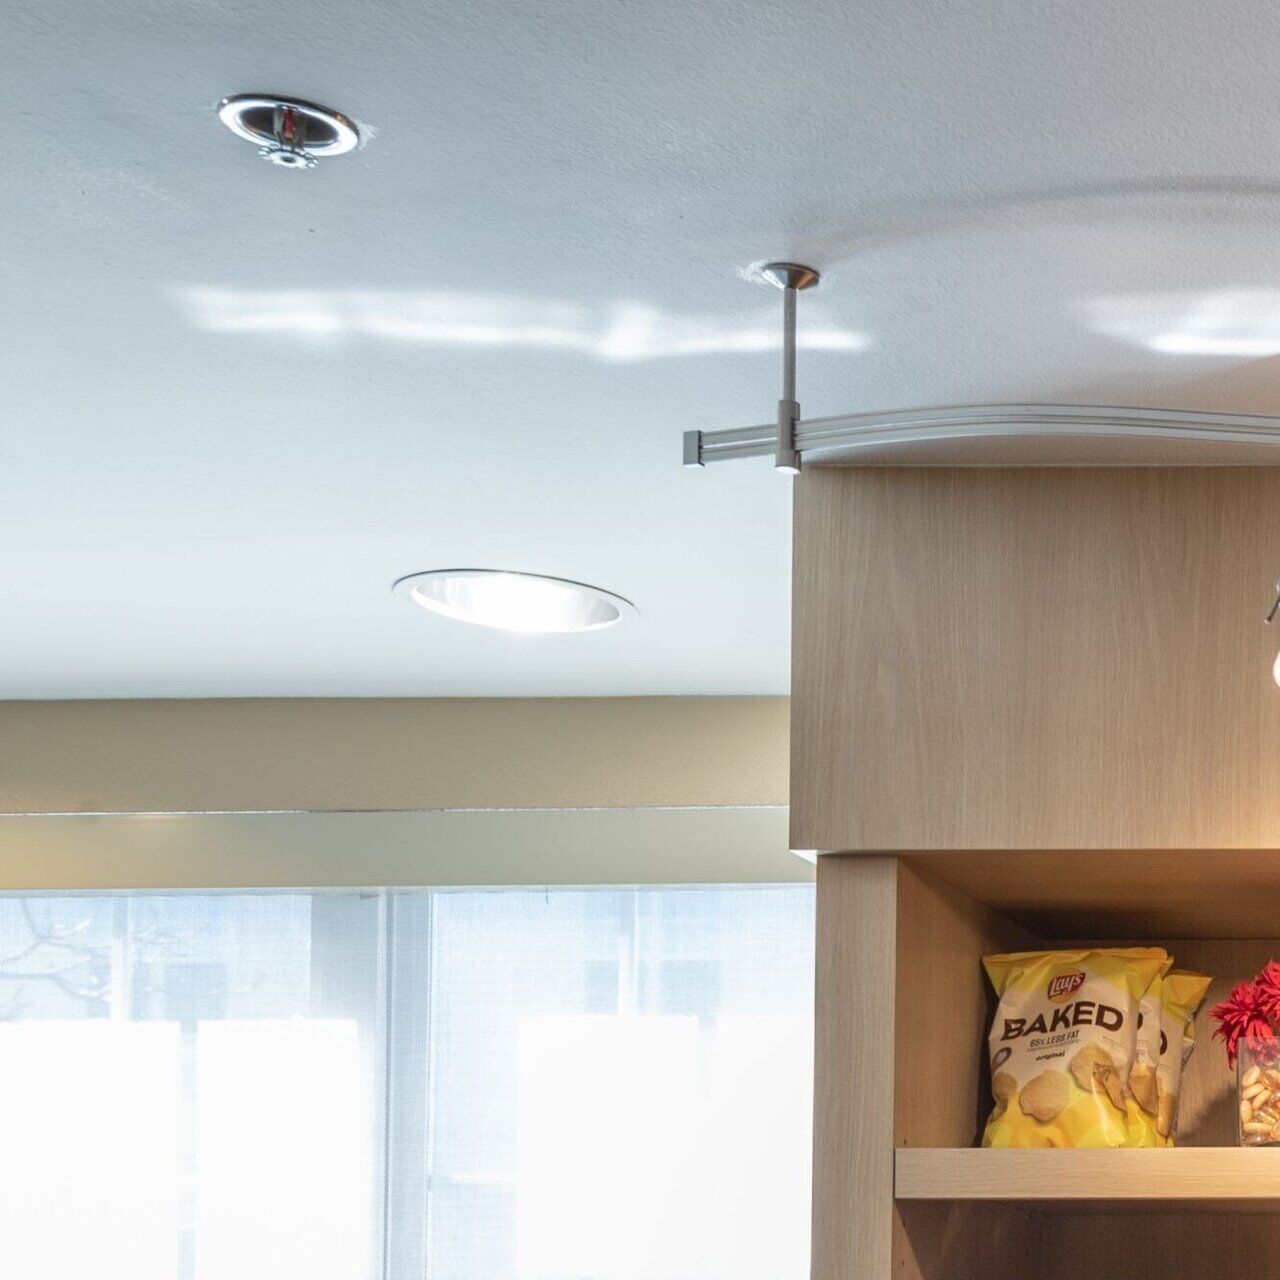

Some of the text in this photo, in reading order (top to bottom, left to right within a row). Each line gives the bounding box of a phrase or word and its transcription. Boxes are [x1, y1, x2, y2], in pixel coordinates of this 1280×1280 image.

[1000, 1001, 1124, 1042] BAKED
[1046, 1033, 1068, 1045] LESS
[1067, 1030, 1080, 1041] FAT
